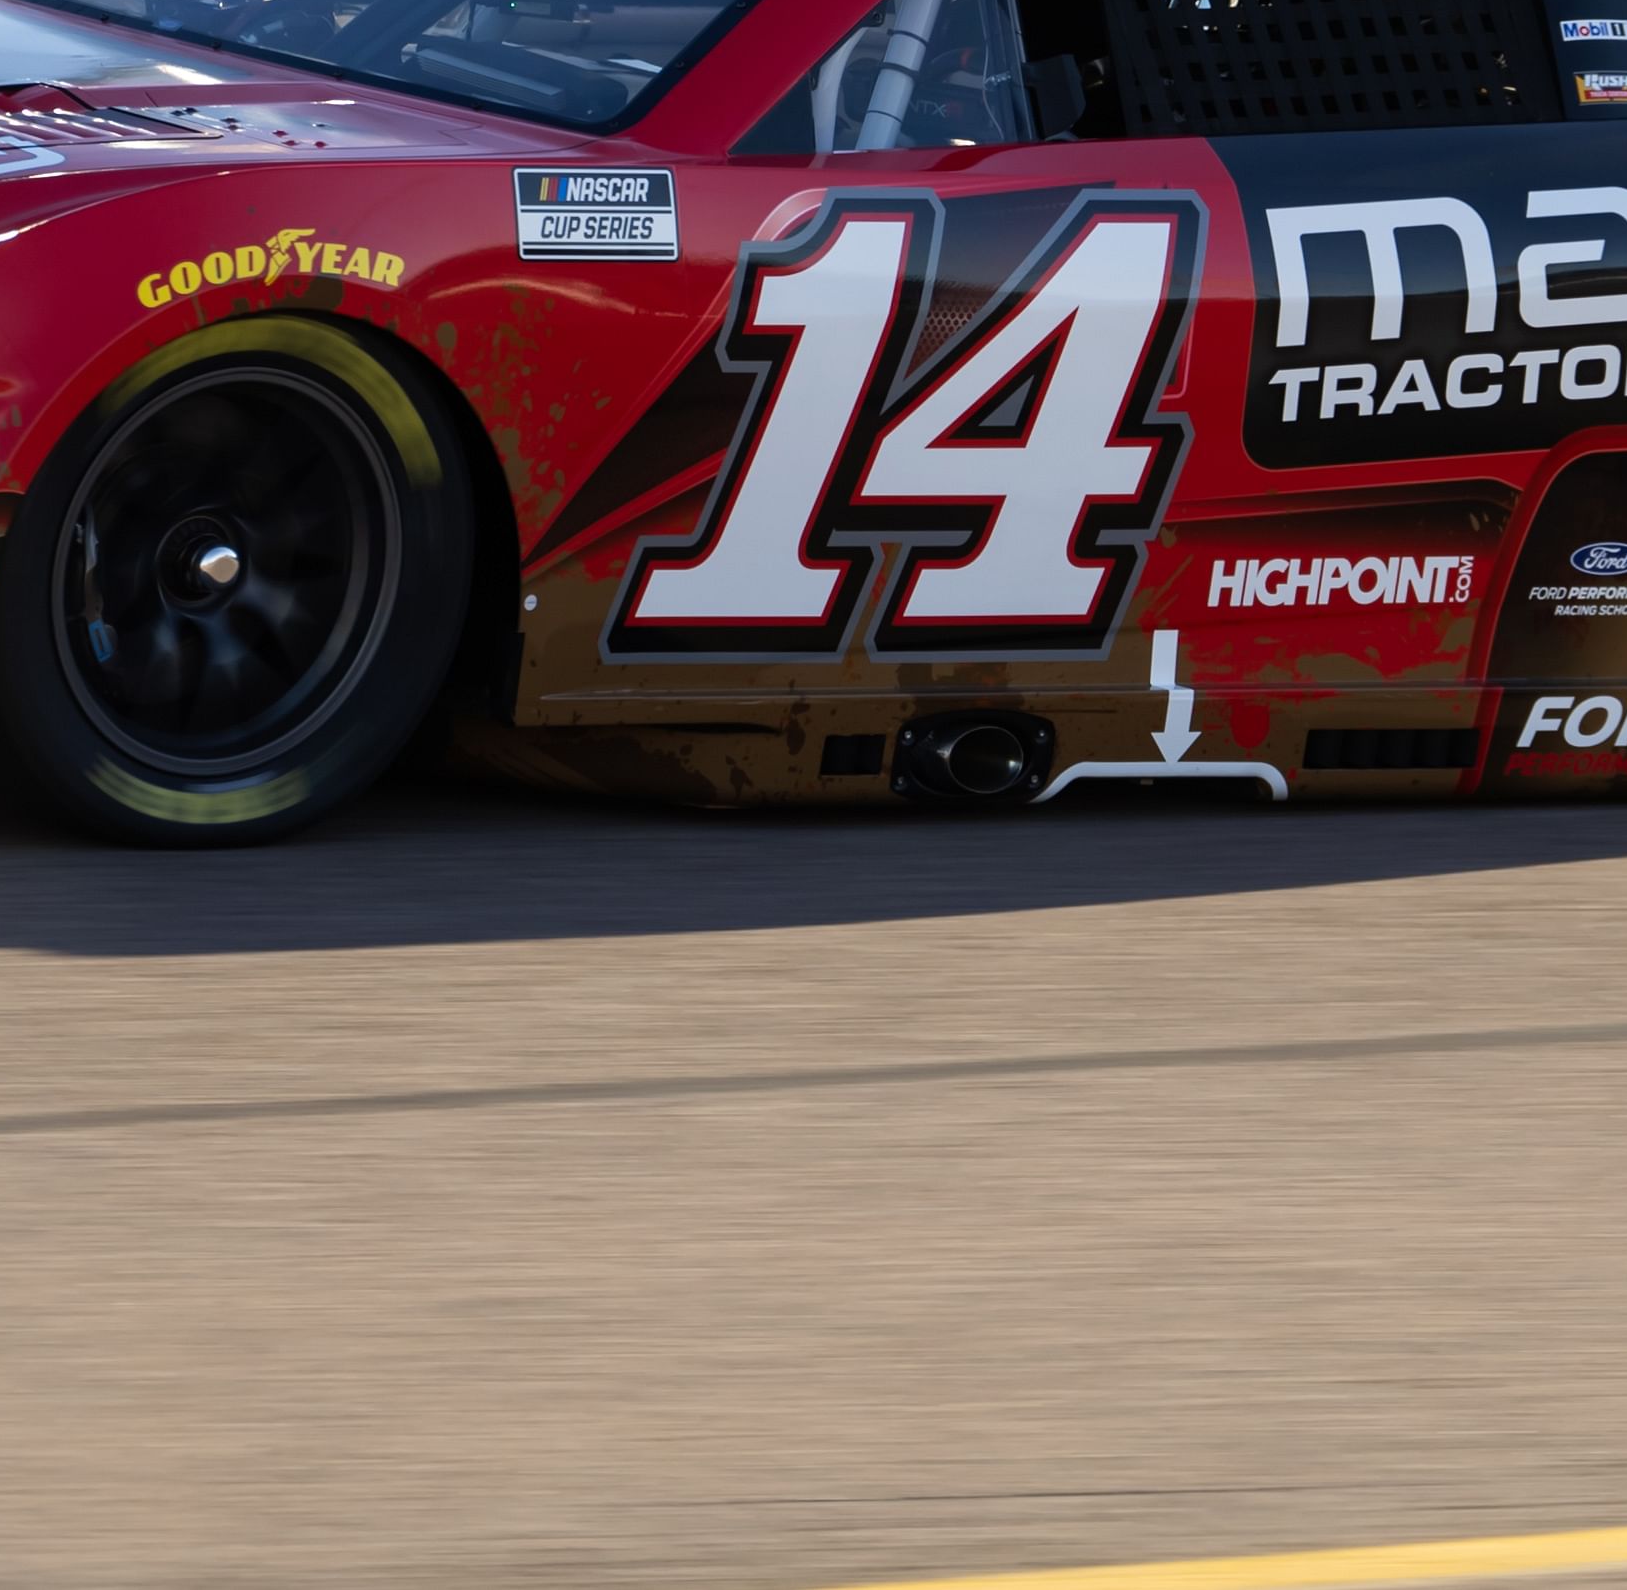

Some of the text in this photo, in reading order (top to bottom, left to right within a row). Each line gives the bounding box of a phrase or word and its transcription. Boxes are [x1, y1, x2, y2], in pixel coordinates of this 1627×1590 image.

[1563, 21, 1626, 38] Mobil 1
[565, 177, 649, 203] NASCAR
[539, 215, 654, 240] CUP SERIES
[137, 229, 405, 308] GOODYEAR
[626, 213, 1177, 626] 14
[1528, 586, 1568, 600] FORD
[1554, 604, 1597, 616] RACING
